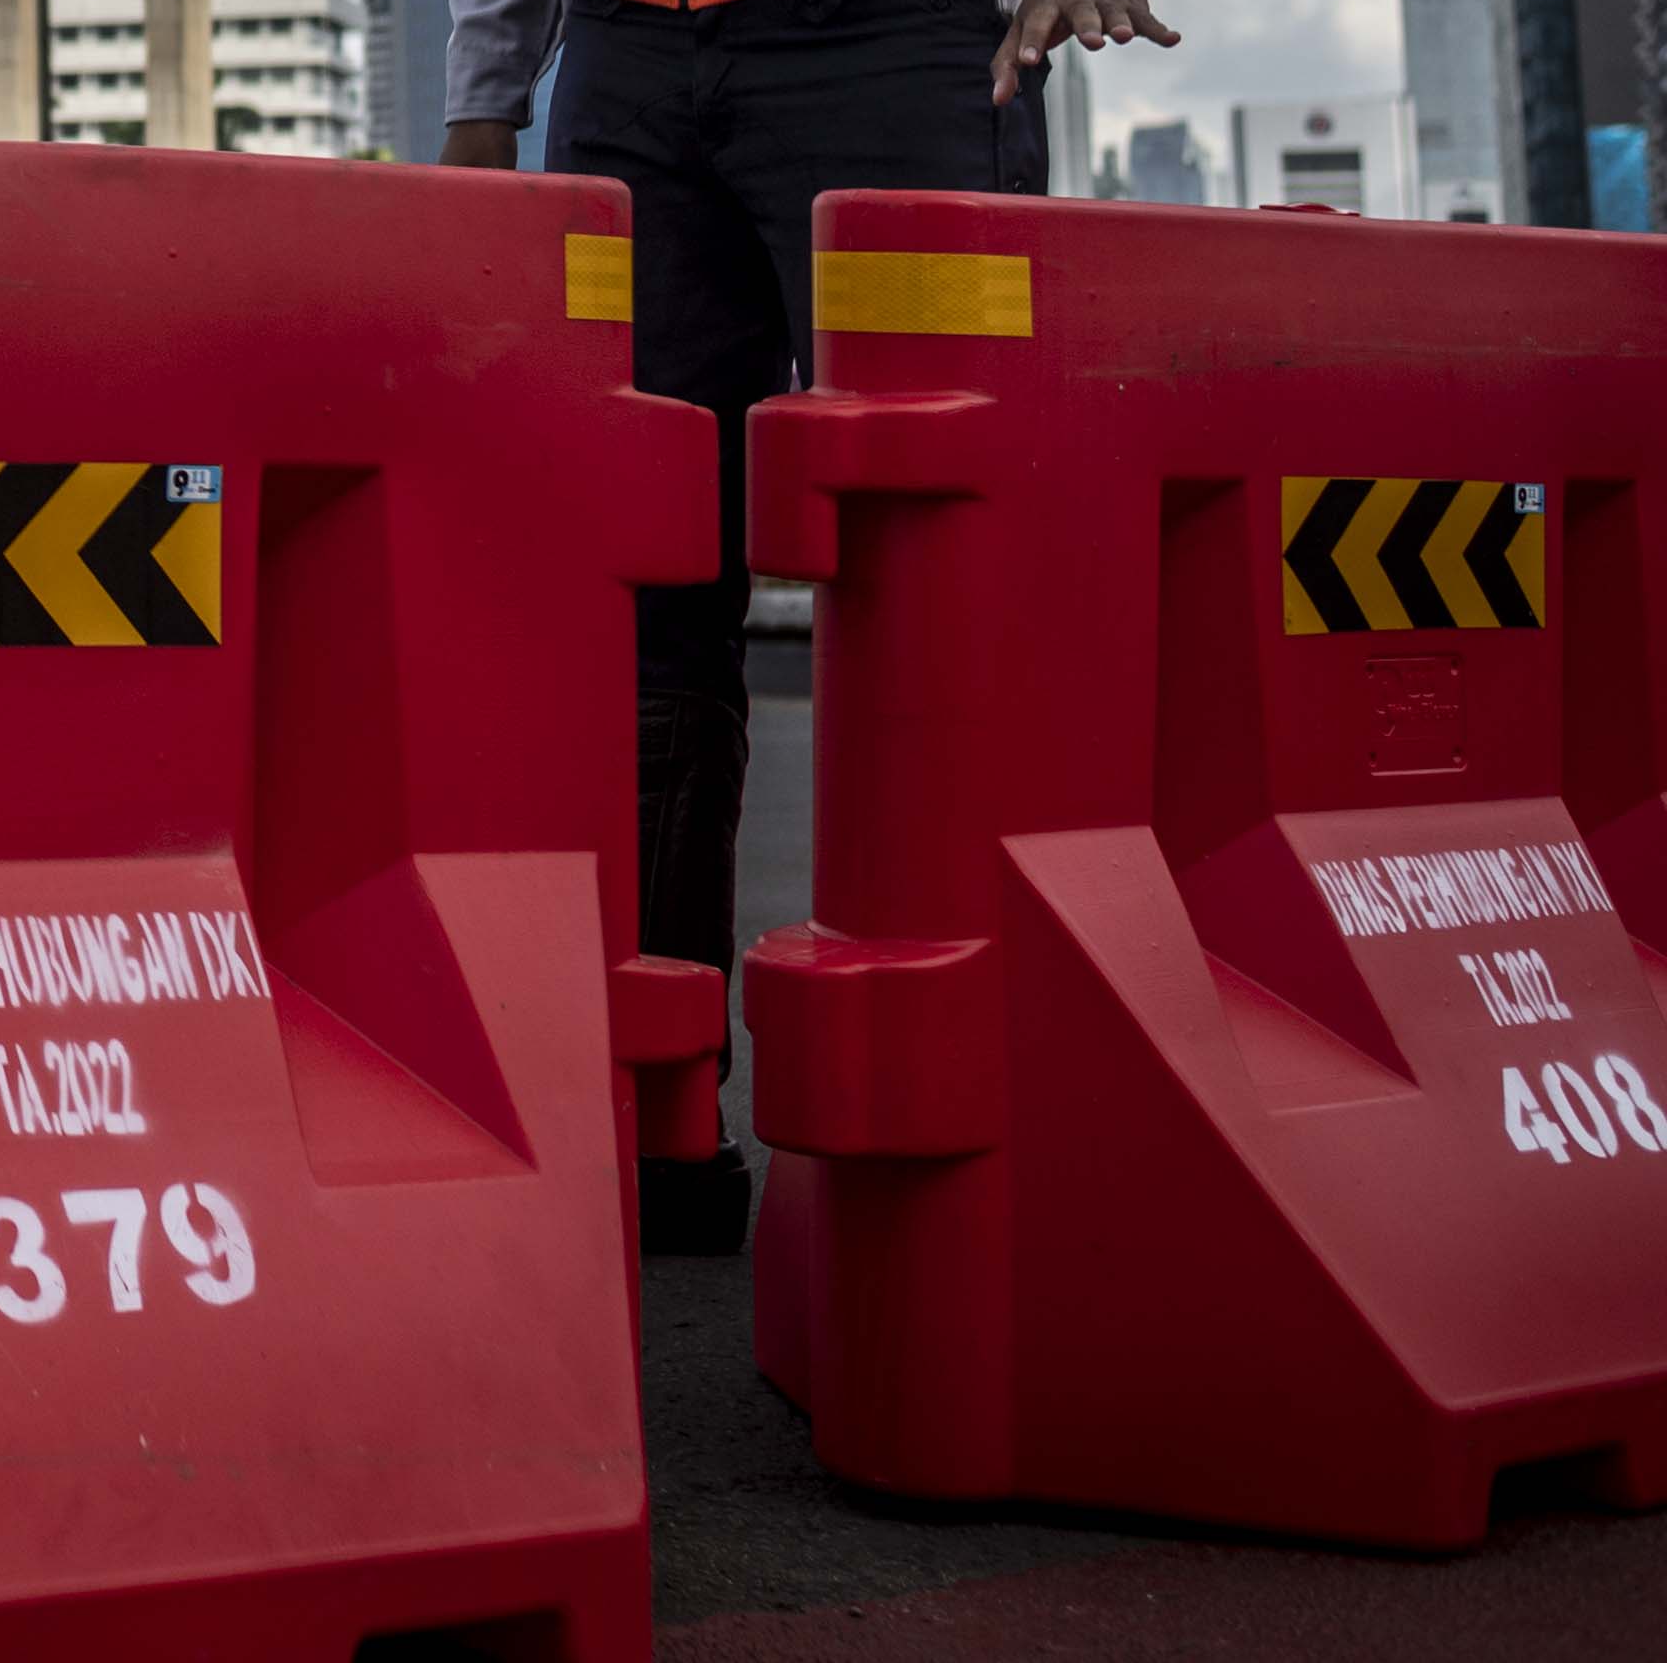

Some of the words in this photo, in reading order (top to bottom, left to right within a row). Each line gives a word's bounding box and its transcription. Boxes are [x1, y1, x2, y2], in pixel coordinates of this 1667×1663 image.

[1310, 860, 1408, 936] DINAS
[1381, 847, 1573, 930] PERHUBUNGAN
[1546, 841, 1615, 913] DKI
[188, 910, 271, 1001] DKI
[1502, 1053, 1667, 1165] 408
